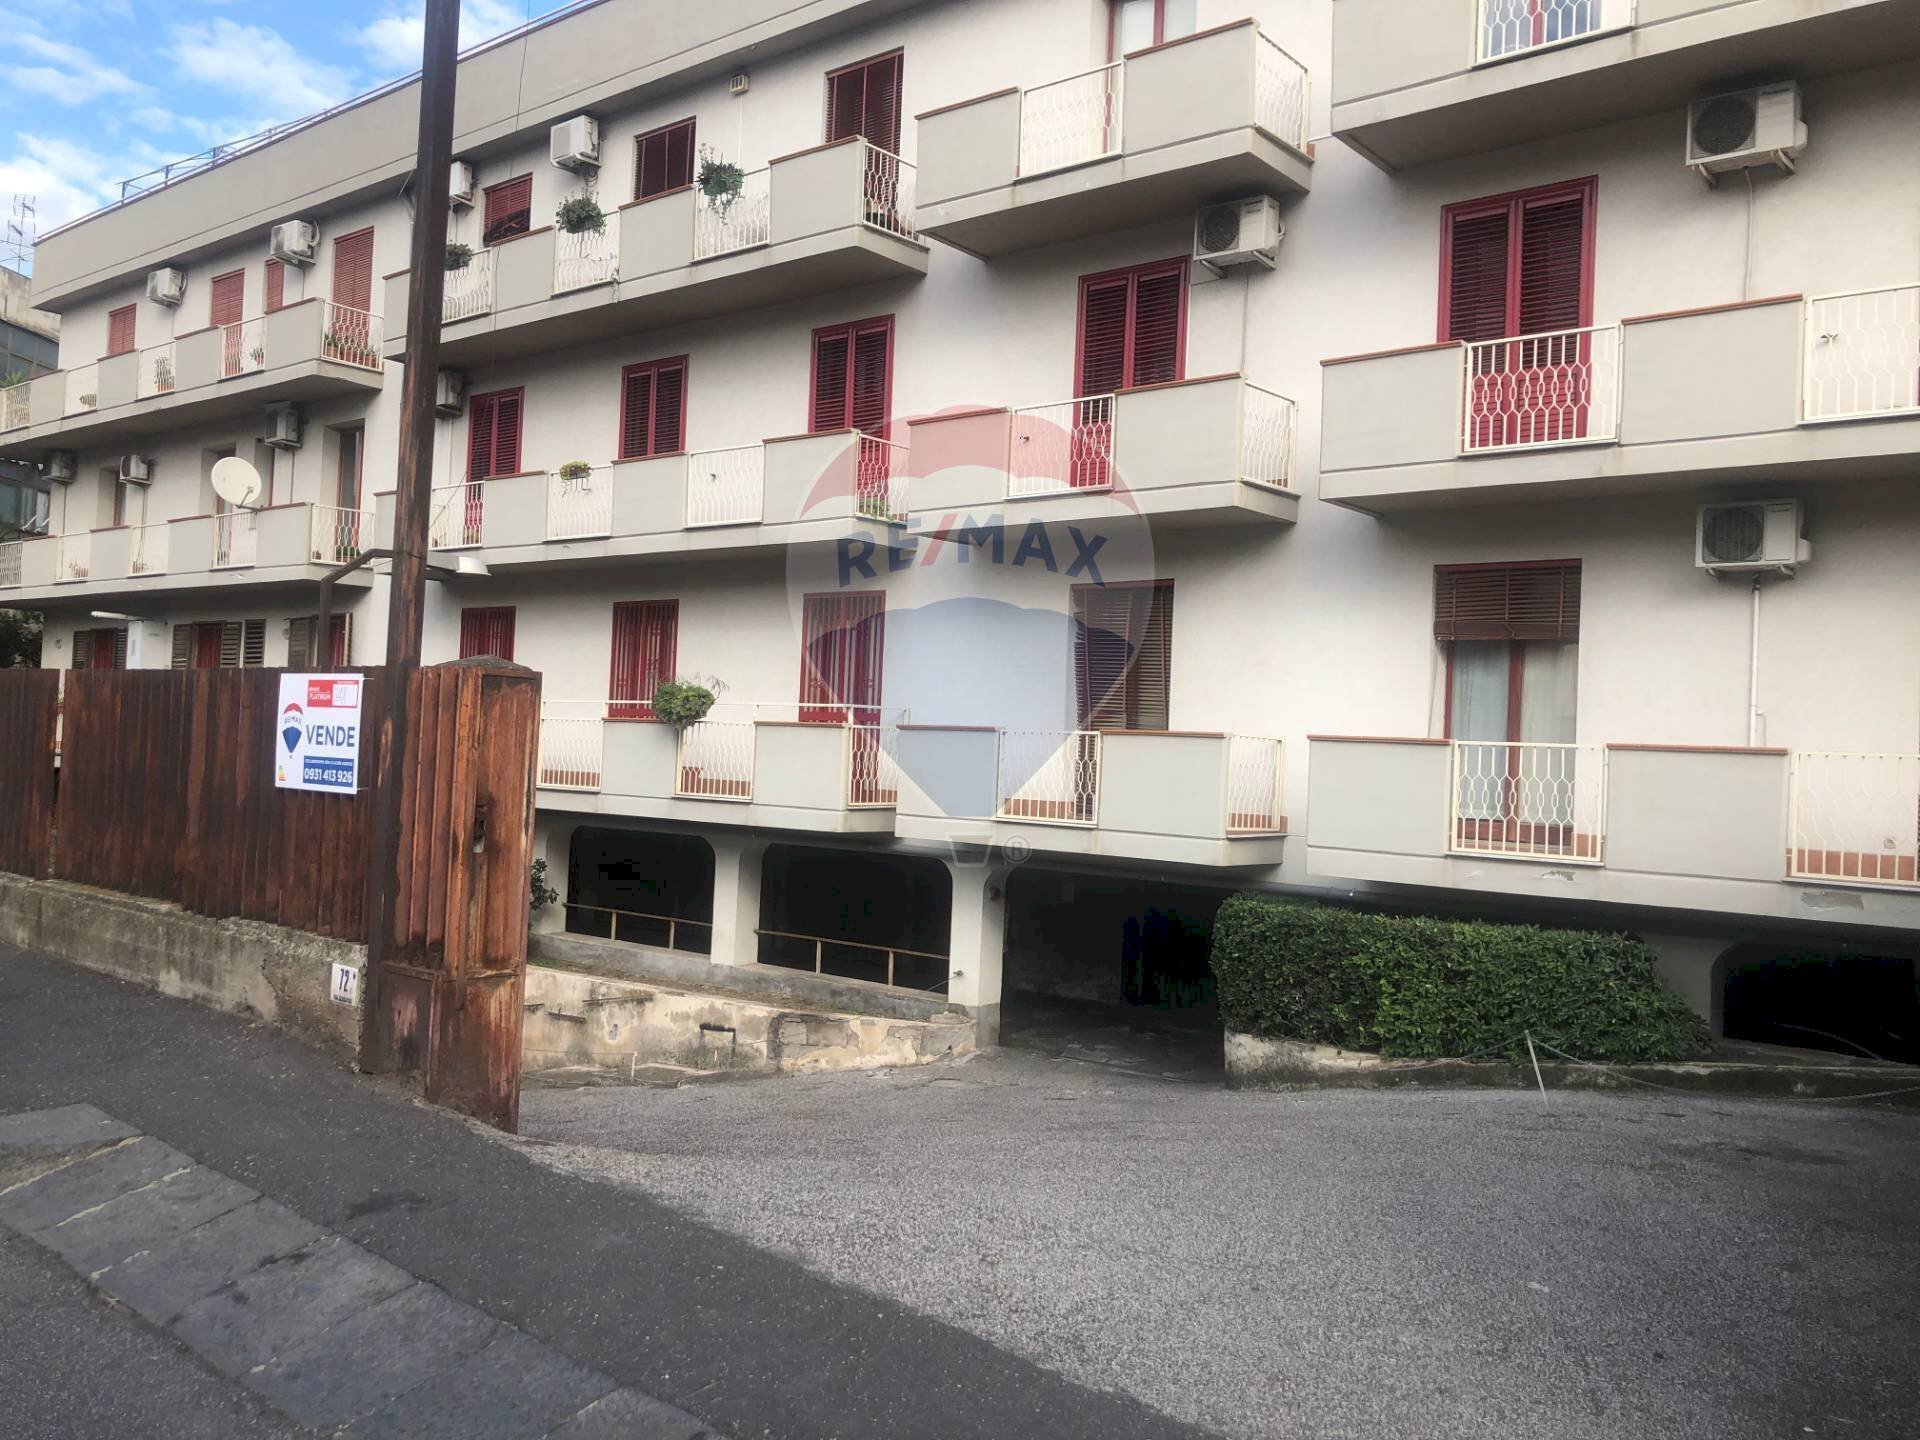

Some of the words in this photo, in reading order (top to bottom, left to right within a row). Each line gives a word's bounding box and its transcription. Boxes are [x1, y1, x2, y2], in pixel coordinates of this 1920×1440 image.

[306, 724, 356, 747] VENDE
[304, 768, 322, 781] 0931
[323, 769, 337, 782] 413
[337, 770, 353, 783] 926
